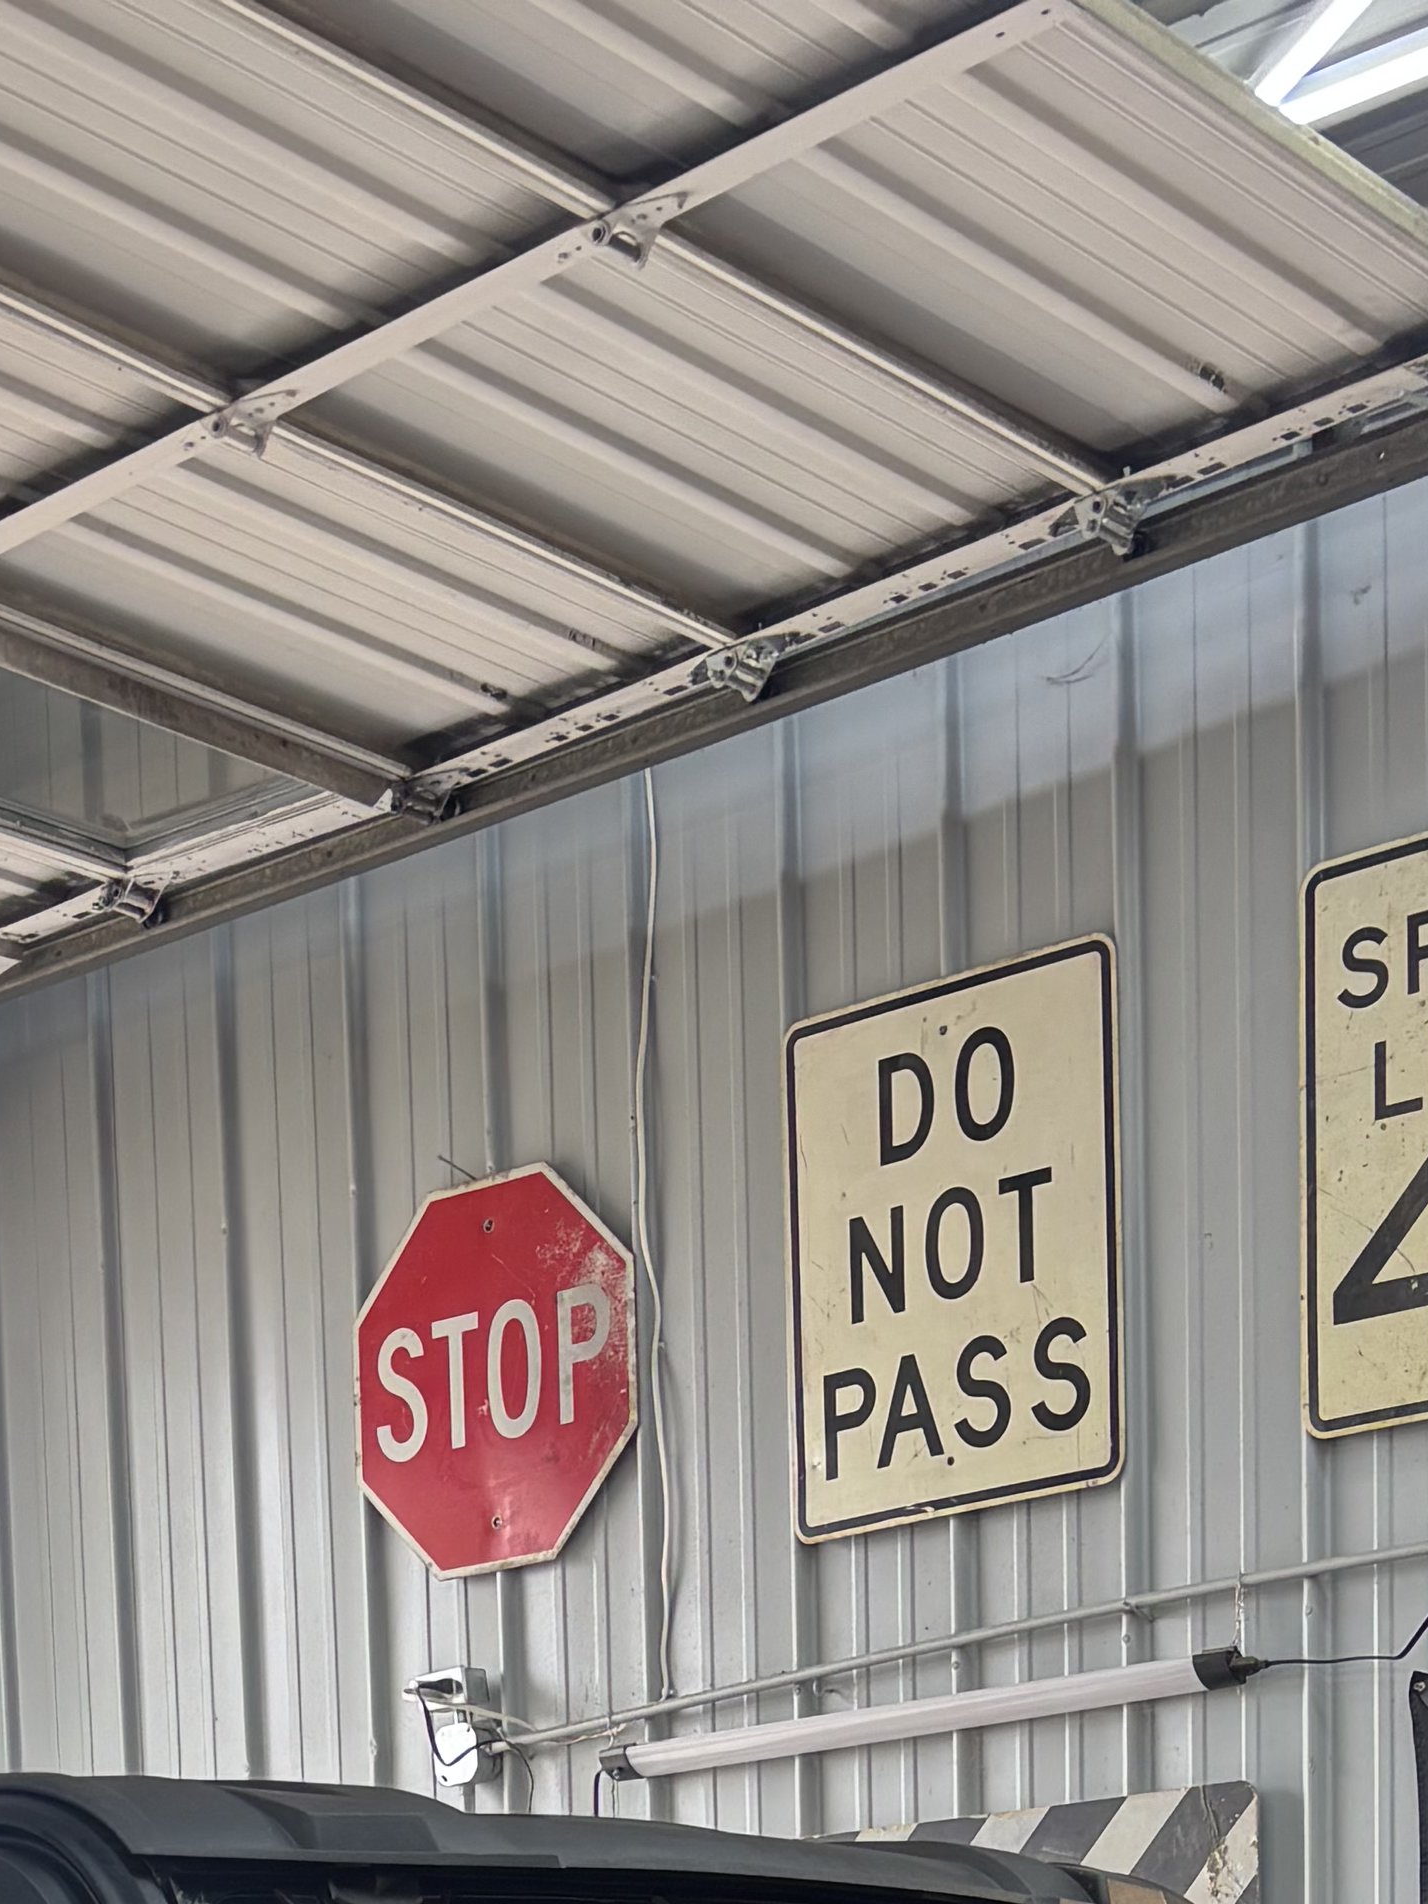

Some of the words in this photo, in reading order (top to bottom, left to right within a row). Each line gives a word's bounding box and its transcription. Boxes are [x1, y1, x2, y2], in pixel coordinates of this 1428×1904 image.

[877, 1026, 1015, 1167] DO
[848, 1167, 1052, 1325] NOT
[376, 1283, 611, 1463] STOP
[823, 1316, 1091, 1481] PASS
